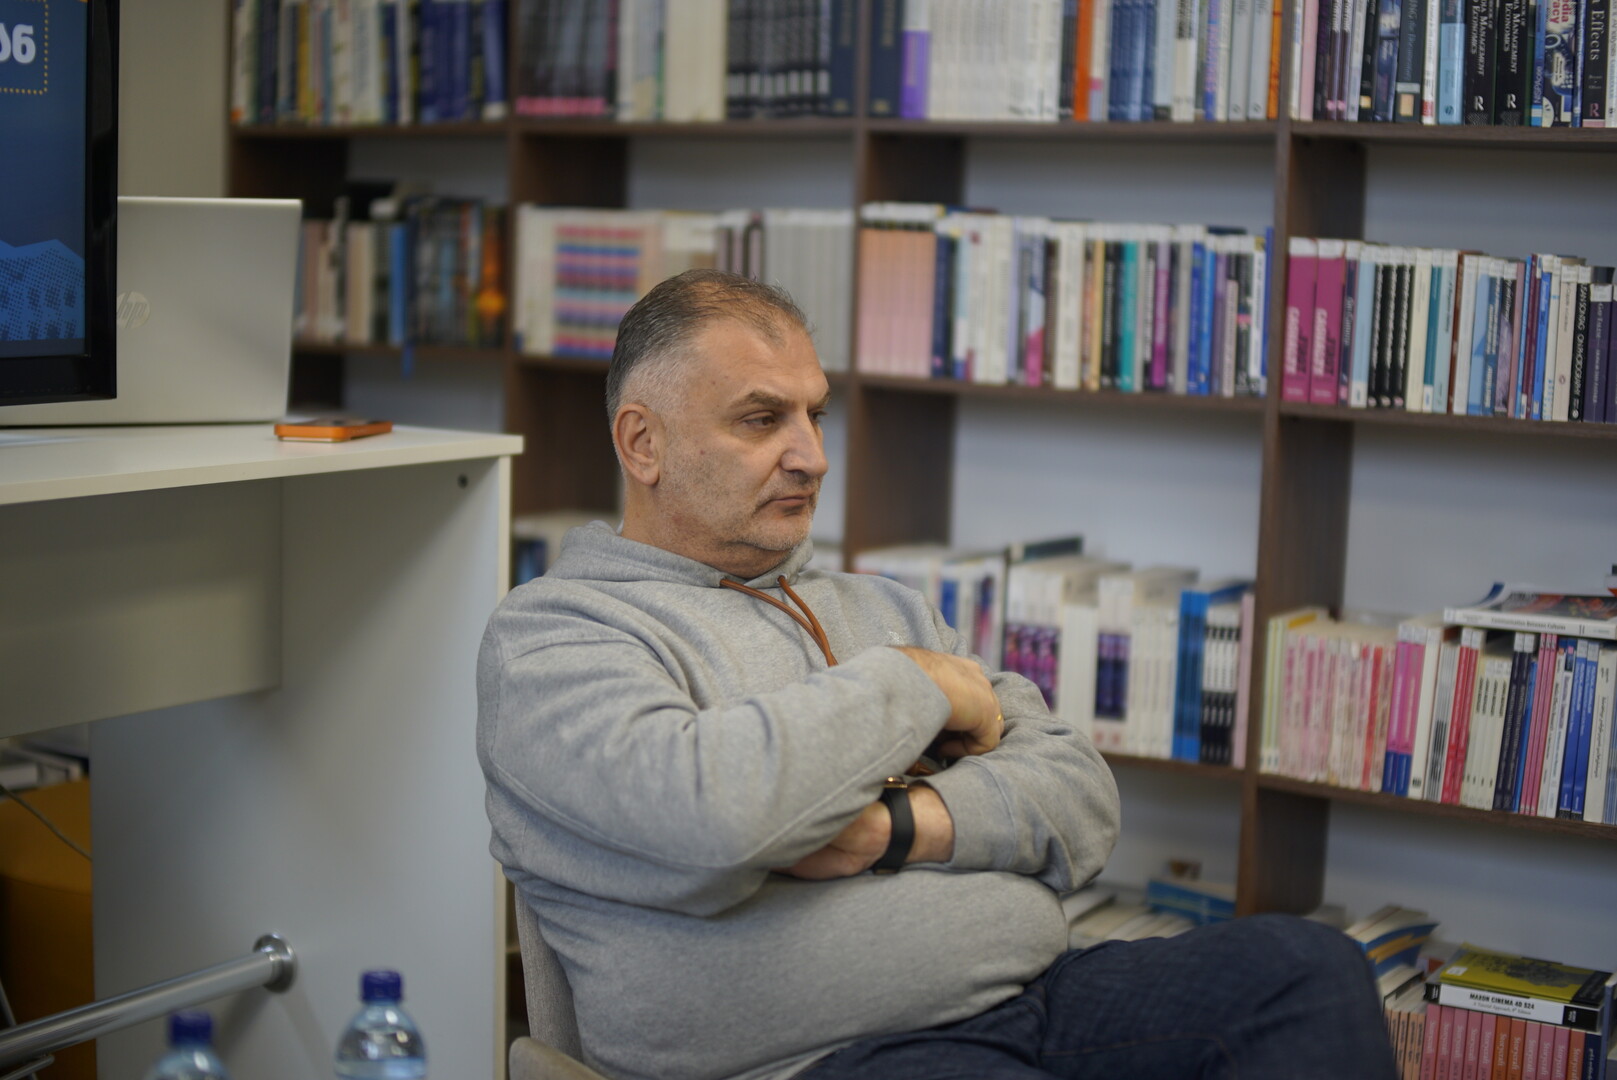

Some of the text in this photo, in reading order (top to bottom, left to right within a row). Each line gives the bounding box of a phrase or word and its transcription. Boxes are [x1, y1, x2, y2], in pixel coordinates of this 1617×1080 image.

[1503, 3, 1511, 52] ECONOMICS
[1510, 14, 1521, 74] MANAGEMENT
[1589, 10, 1606, 61] Effects
[1469, 992, 1490, 1002] MAXON
[1491, 997, 1514, 1006] CINEMA
[1480, 1031, 1492, 1064] Storycraft
[1495, 1033, 1508, 1067] Storycraft
[1509, 1037, 1522, 1070] Storycraft
[1524, 1039, 1537, 1073] Storycraft
[1538, 1042, 1551, 1075] Storycraft
[1553, 1045, 1566, 1078] Storycraft
